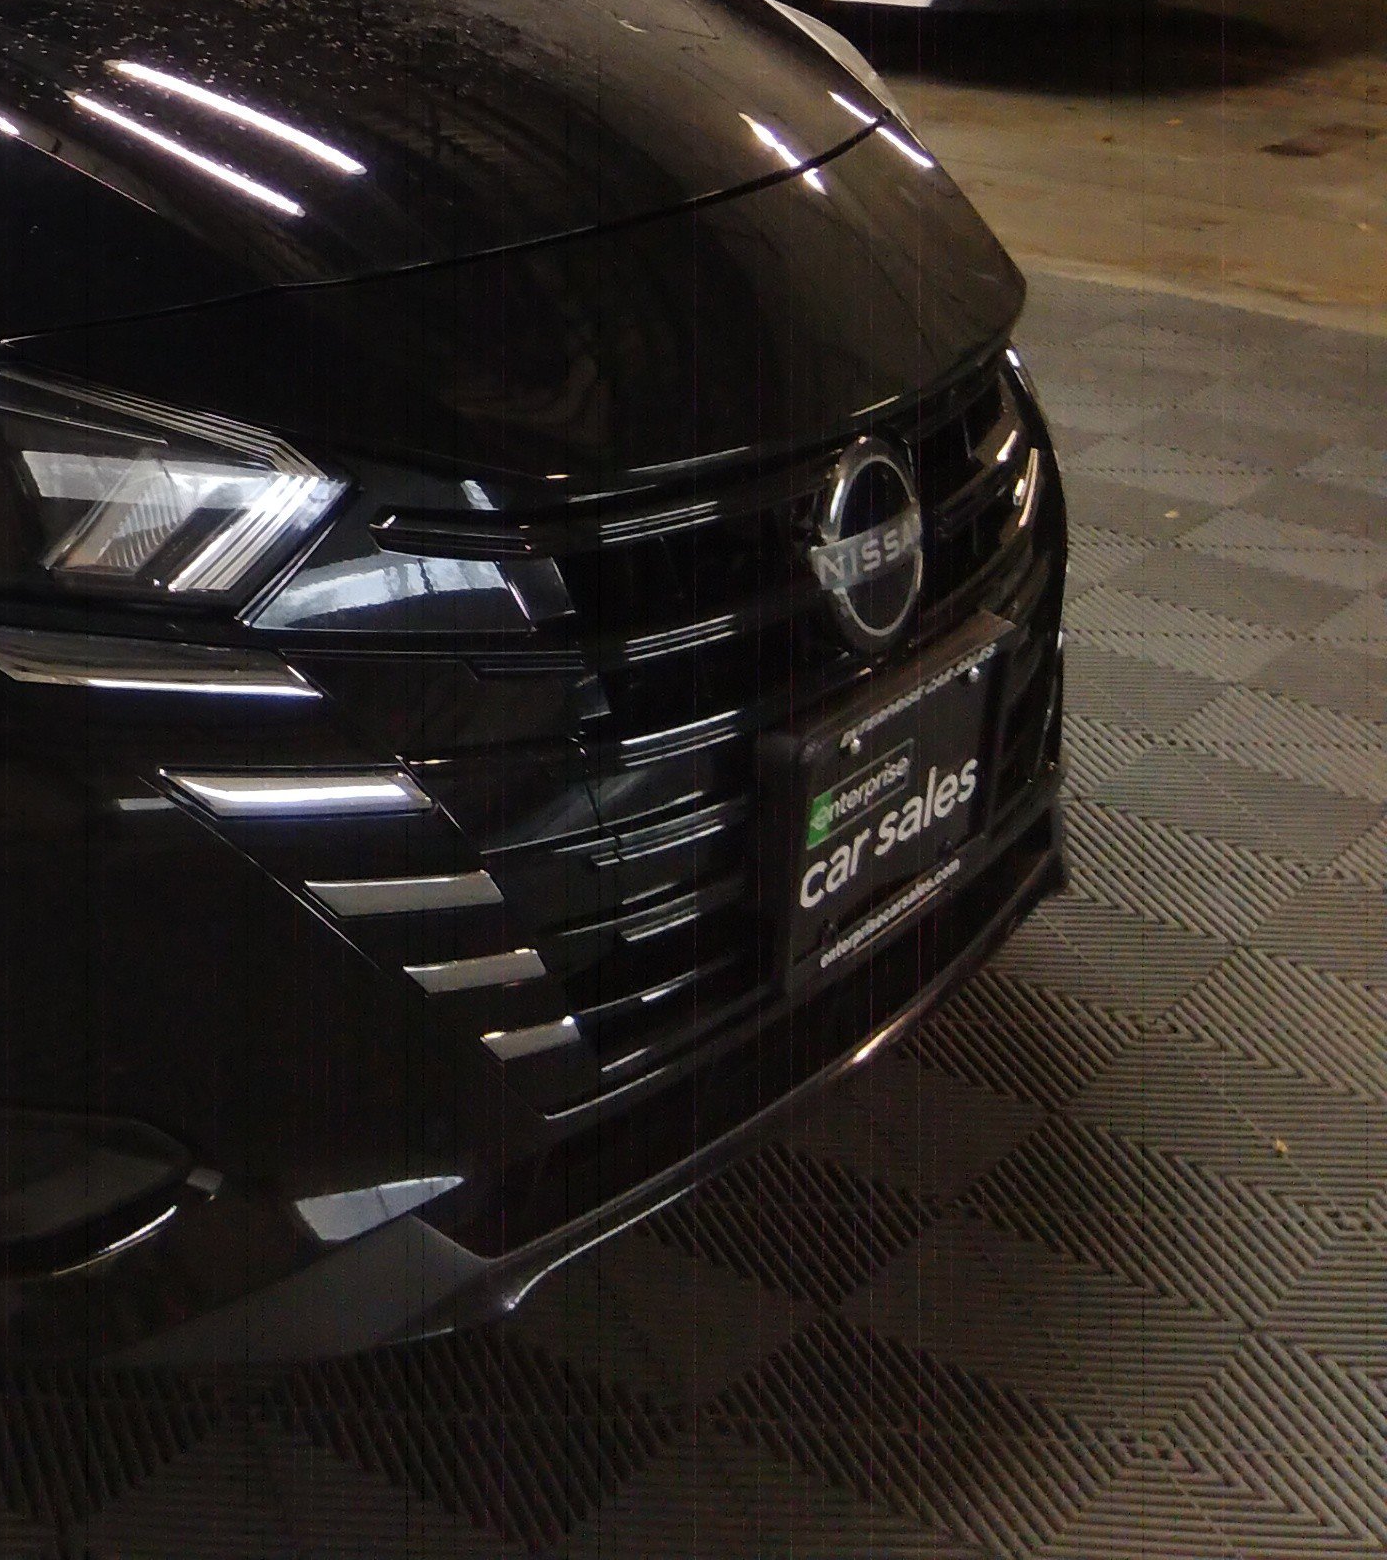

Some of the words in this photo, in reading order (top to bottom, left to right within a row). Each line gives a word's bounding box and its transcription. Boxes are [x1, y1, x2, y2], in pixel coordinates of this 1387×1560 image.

[813, 516, 920, 588] NISSA
[809, 756, 910, 831] enterprise
[799, 827, 873, 908] car
[874, 758, 979, 856] sales
